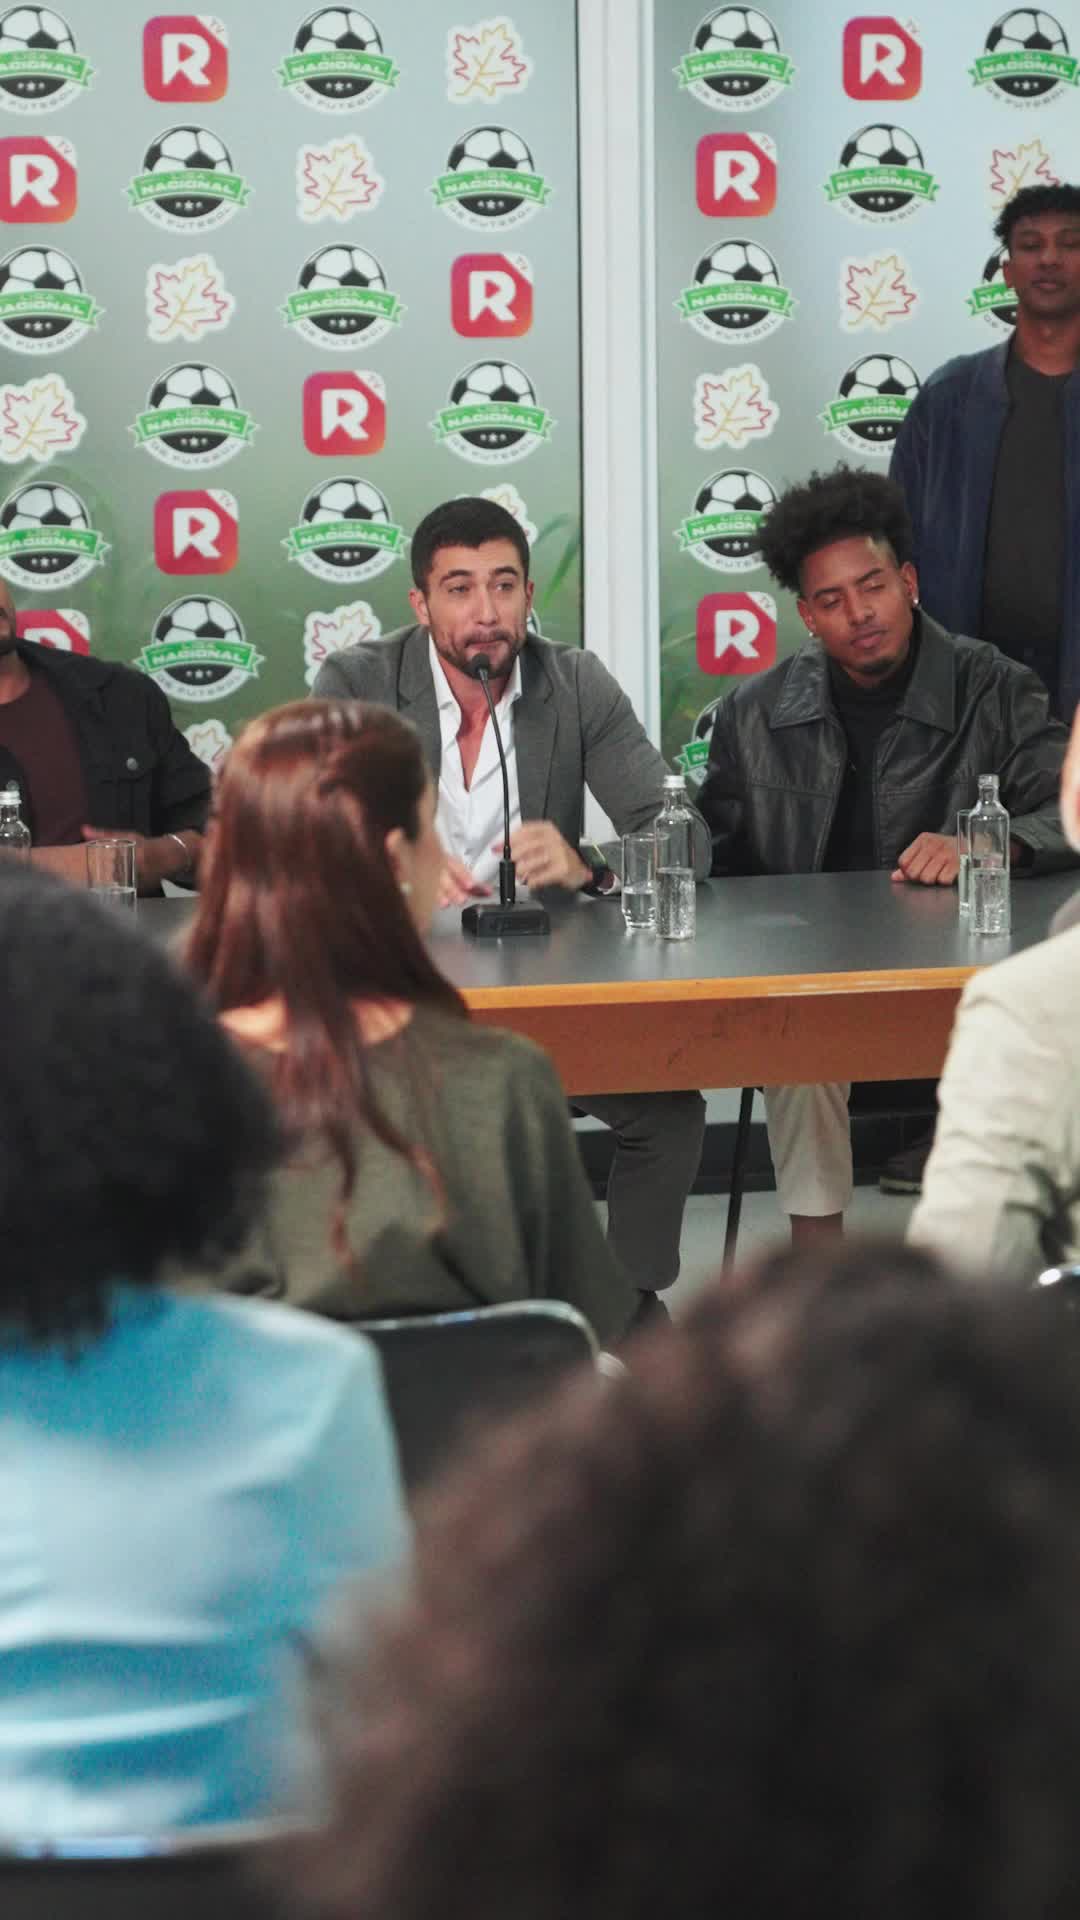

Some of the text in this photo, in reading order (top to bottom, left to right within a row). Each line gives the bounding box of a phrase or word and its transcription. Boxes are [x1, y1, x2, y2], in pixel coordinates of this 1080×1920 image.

[162, 33, 211, 86] R
[691, 59, 780, 74] NACIONAL
[860, 33, 906, 86] R
[981, 60, 1070, 75] NACIONAL
[291, 60, 386, 76] NACIONAL
[10, 154, 59, 206] R
[714, 150, 761, 201] R
[836, 176, 926, 191] NACIONAL
[141, 180, 236, 195] NACIONAL
[443, 178, 538, 194] NACIONAL
[469, 270, 516, 321] R
[691, 291, 780, 306] NACIONAL
[295, 296, 390, 312] NACIONAL
[321, 388, 369, 440] R
[445, 412, 540, 427] NACIONAL
[146, 416, 242, 431] NACIONAL
[173, 508, 220, 558] R
[298, 529, 394, 544] NACIONAL
[0, 536, 92, 551] NACIONAL
[715, 609, 760, 659] R
[151, 648, 246, 664] NACIONAL
